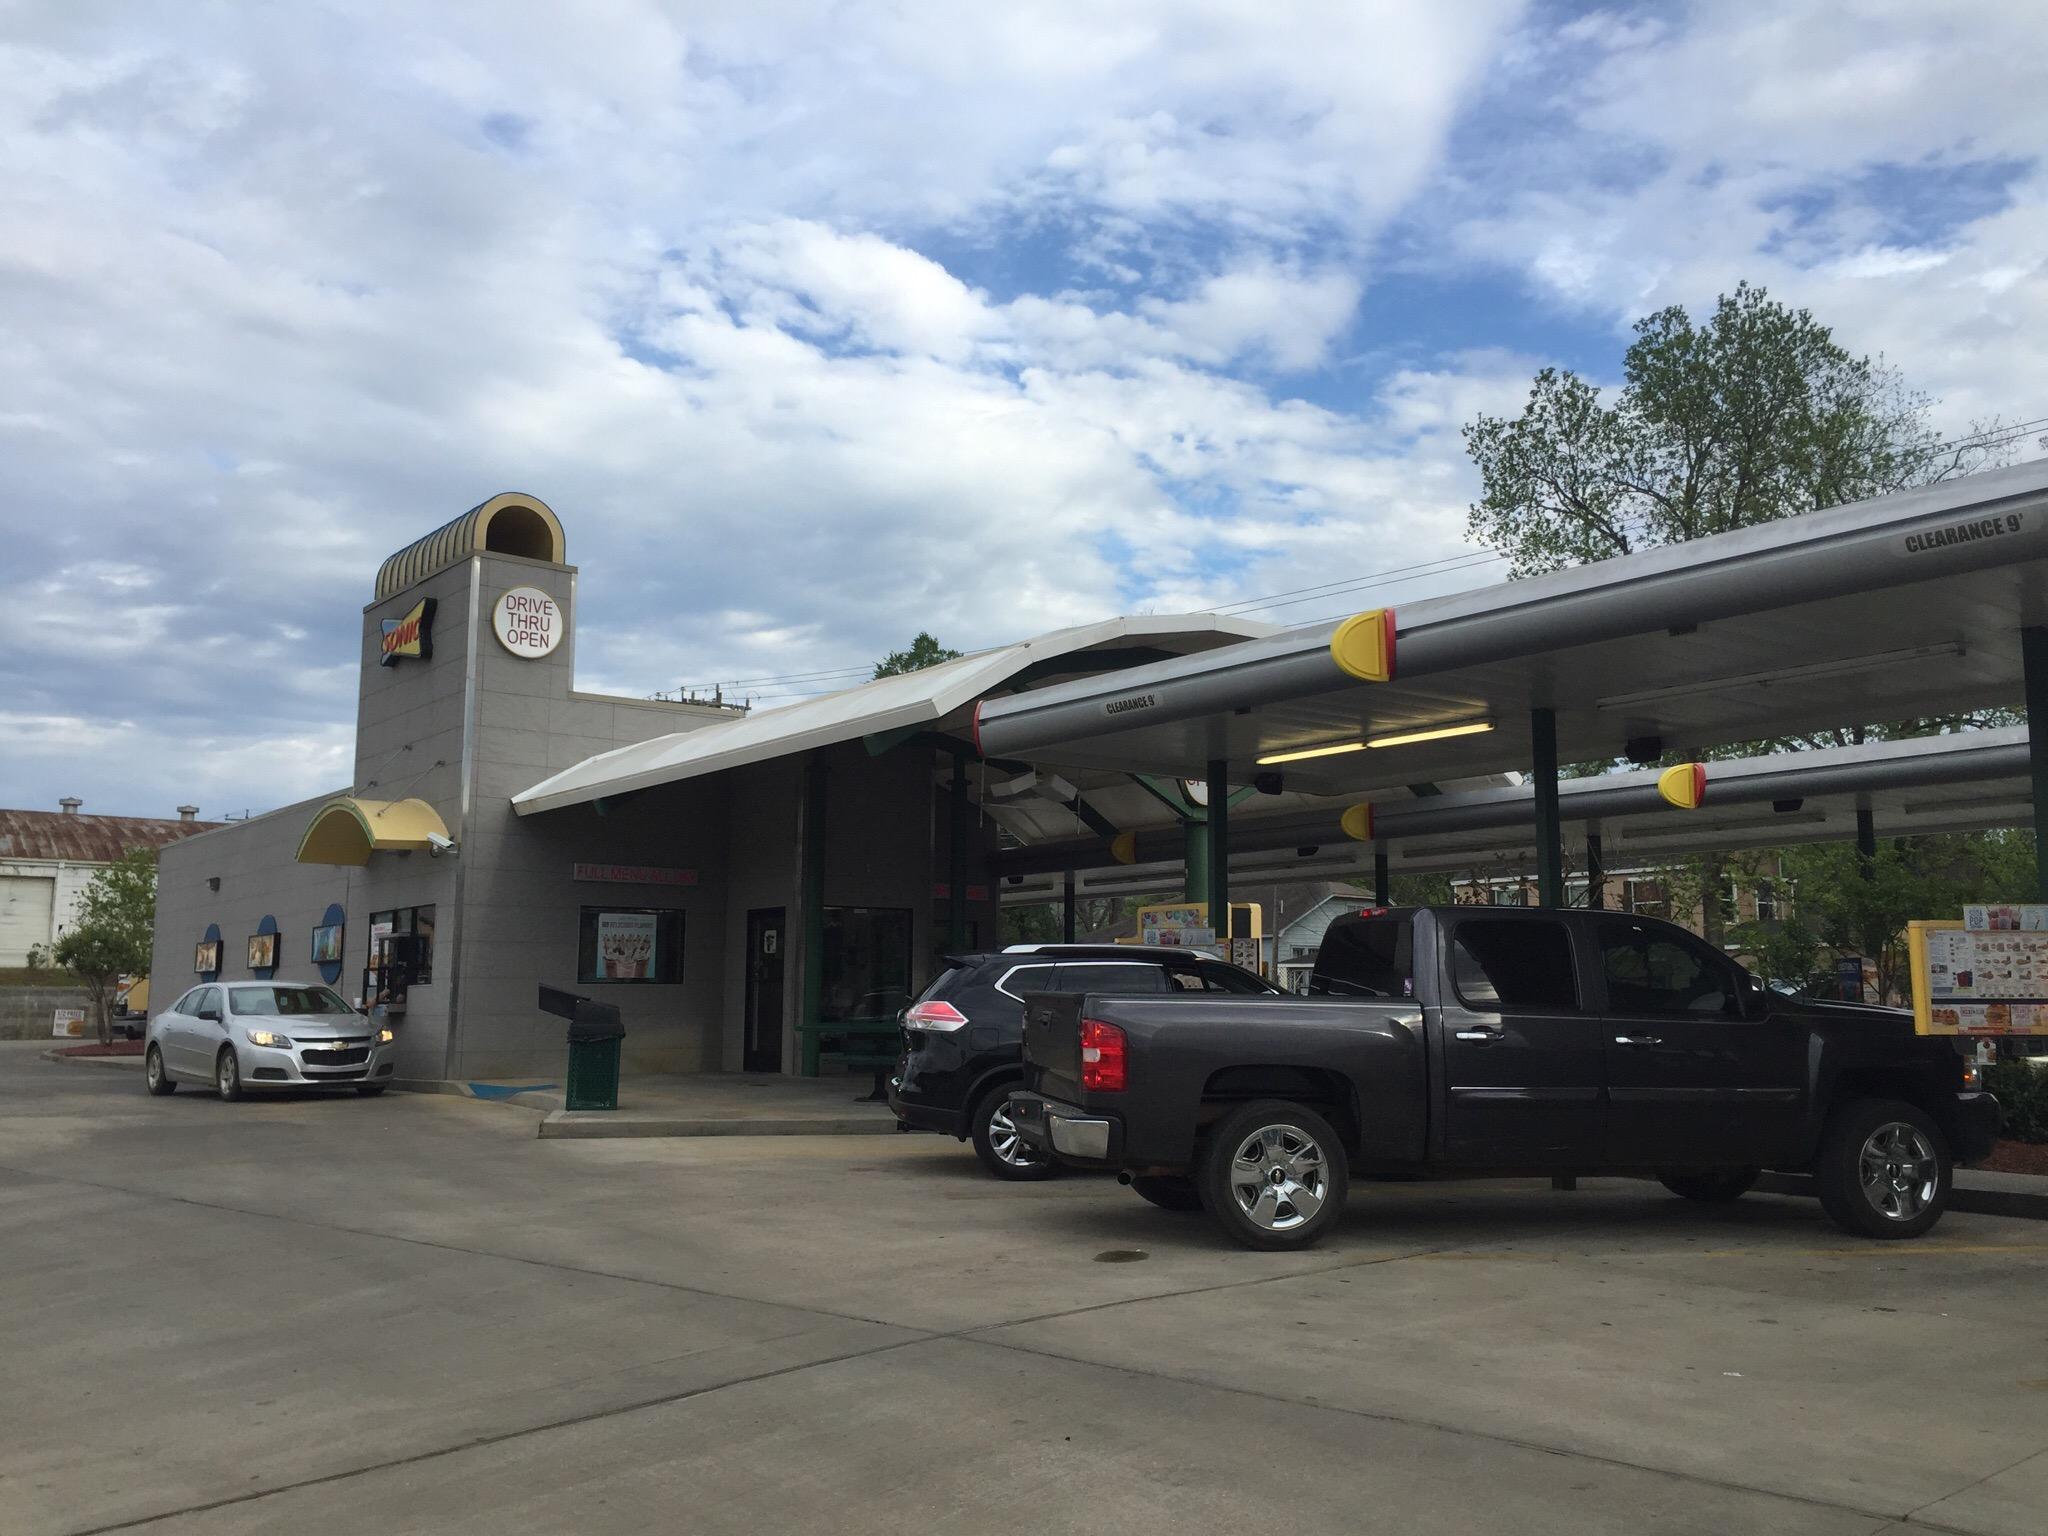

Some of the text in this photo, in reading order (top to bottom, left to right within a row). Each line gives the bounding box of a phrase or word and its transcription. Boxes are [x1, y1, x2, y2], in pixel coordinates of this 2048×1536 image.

[1905, 513, 2024, 552] CLEARANCE 9'
[506, 594, 553, 616] DRIVE
[507, 611, 550, 632] THRU
[382, 617, 421, 654] SONIC
[507, 629, 550, 649] OPEN
[1106, 696, 1148, 714] CLEARANCE
